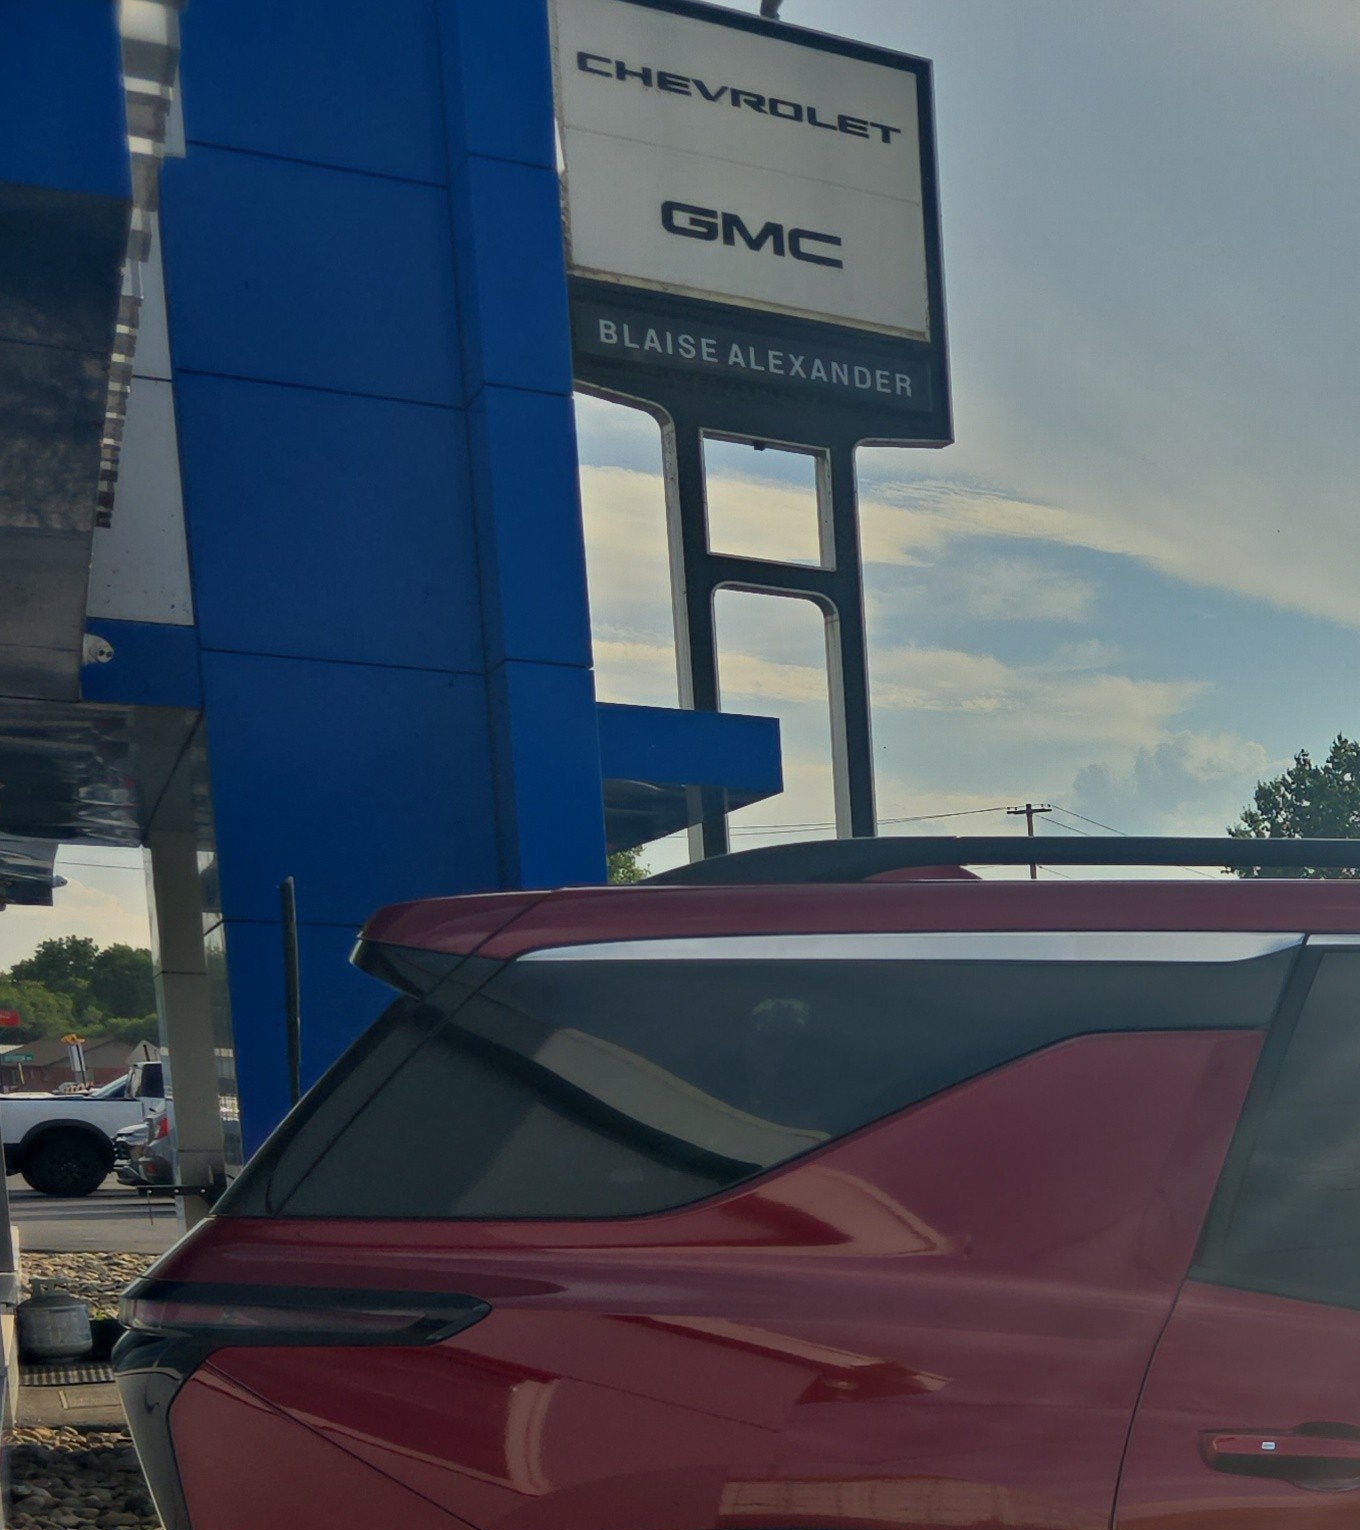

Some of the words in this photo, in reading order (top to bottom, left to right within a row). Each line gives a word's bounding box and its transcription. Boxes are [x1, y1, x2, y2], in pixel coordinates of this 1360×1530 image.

[576, 51, 901, 144] CHEVROLET
[660, 200, 844, 270] GMC
[599, 318, 718, 364] BLAISE
[727, 343, 913, 398] ALEXANDER
